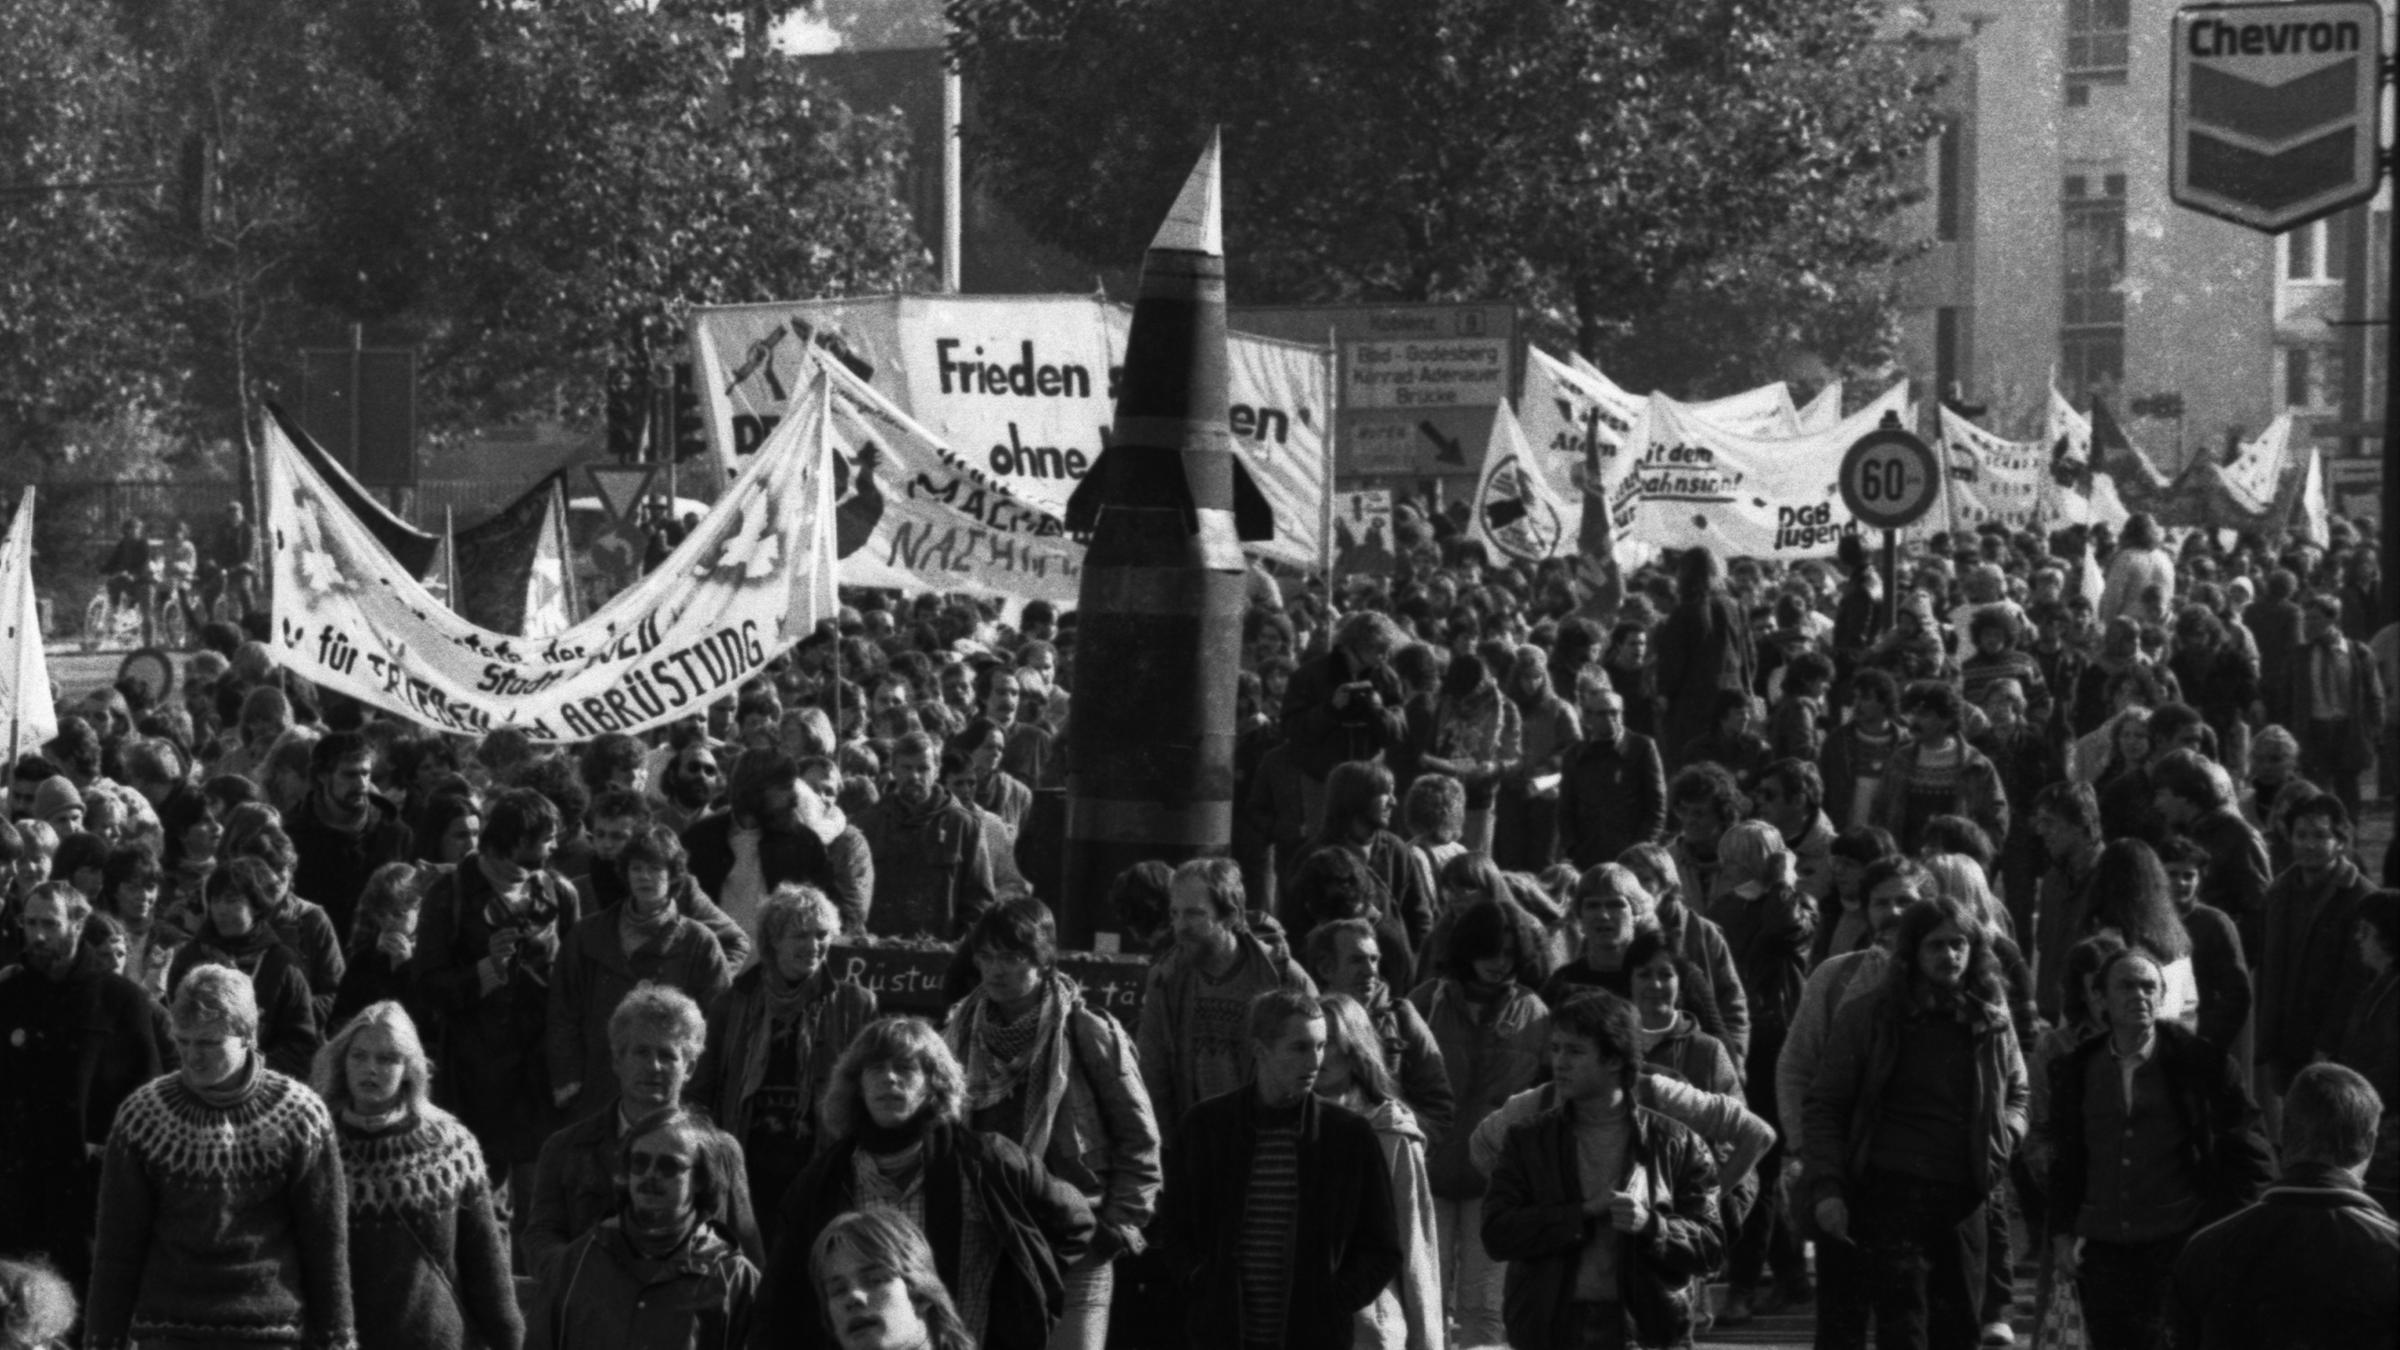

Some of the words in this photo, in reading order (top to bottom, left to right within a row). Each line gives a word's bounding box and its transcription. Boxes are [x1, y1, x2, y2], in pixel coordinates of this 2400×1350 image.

[2189, 19, 2359, 56] Chevron
[936, 338, 1091, 399] Frieden
[989, 422, 1087, 480] ohne
[1668, 442, 1713, 464] dem
[1861, 458, 1904, 500] 60
[1778, 502, 1831, 527] DGB
[319, 625, 358, 674] für
[561, 620, 764, 737] ABRÜSTUNG
[477, 663, 563, 695] Stadt
[845, 956, 945, 992] Rüstu
